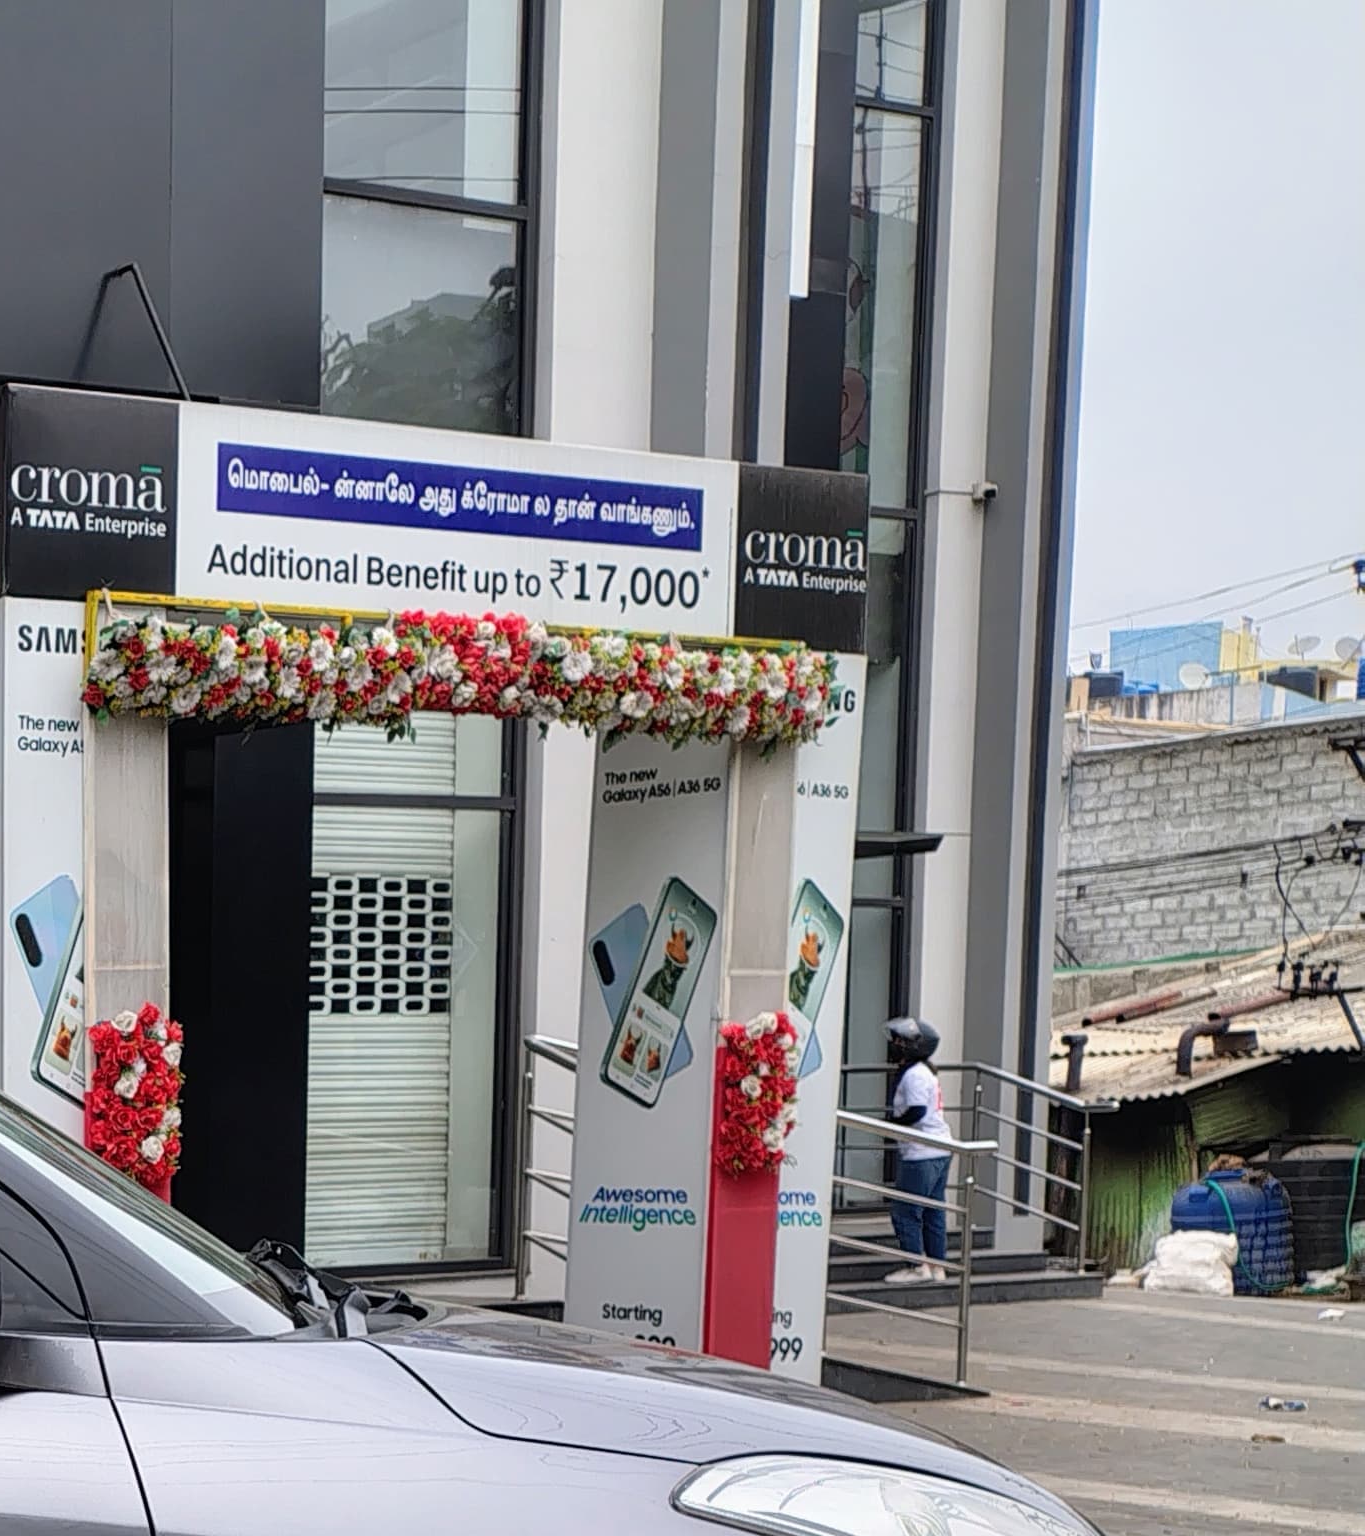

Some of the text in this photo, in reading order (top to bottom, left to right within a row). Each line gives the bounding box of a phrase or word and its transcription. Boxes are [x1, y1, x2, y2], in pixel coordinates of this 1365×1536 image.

[554, 491, 596, 526] தான்
[10, 507, 168, 539] A TATA Enterprise
[206, 543, 358, 585] Additional
[366, 555, 468, 593] Benefit
[474, 568, 508, 604] up
[515, 567, 541, 599] to
[743, 566, 867, 595] A TATA Enterprise
[17, 714, 81, 733] The new
[17, 736, 69, 758] Galaxy
[604, 768, 659, 786] The new
[602, 785, 648, 805] Galaxy
[591, 1186, 688, 1204] Awesome
[578, 1203, 697, 1232] Intelligence
[601, 1303, 663, 1327] Starting
